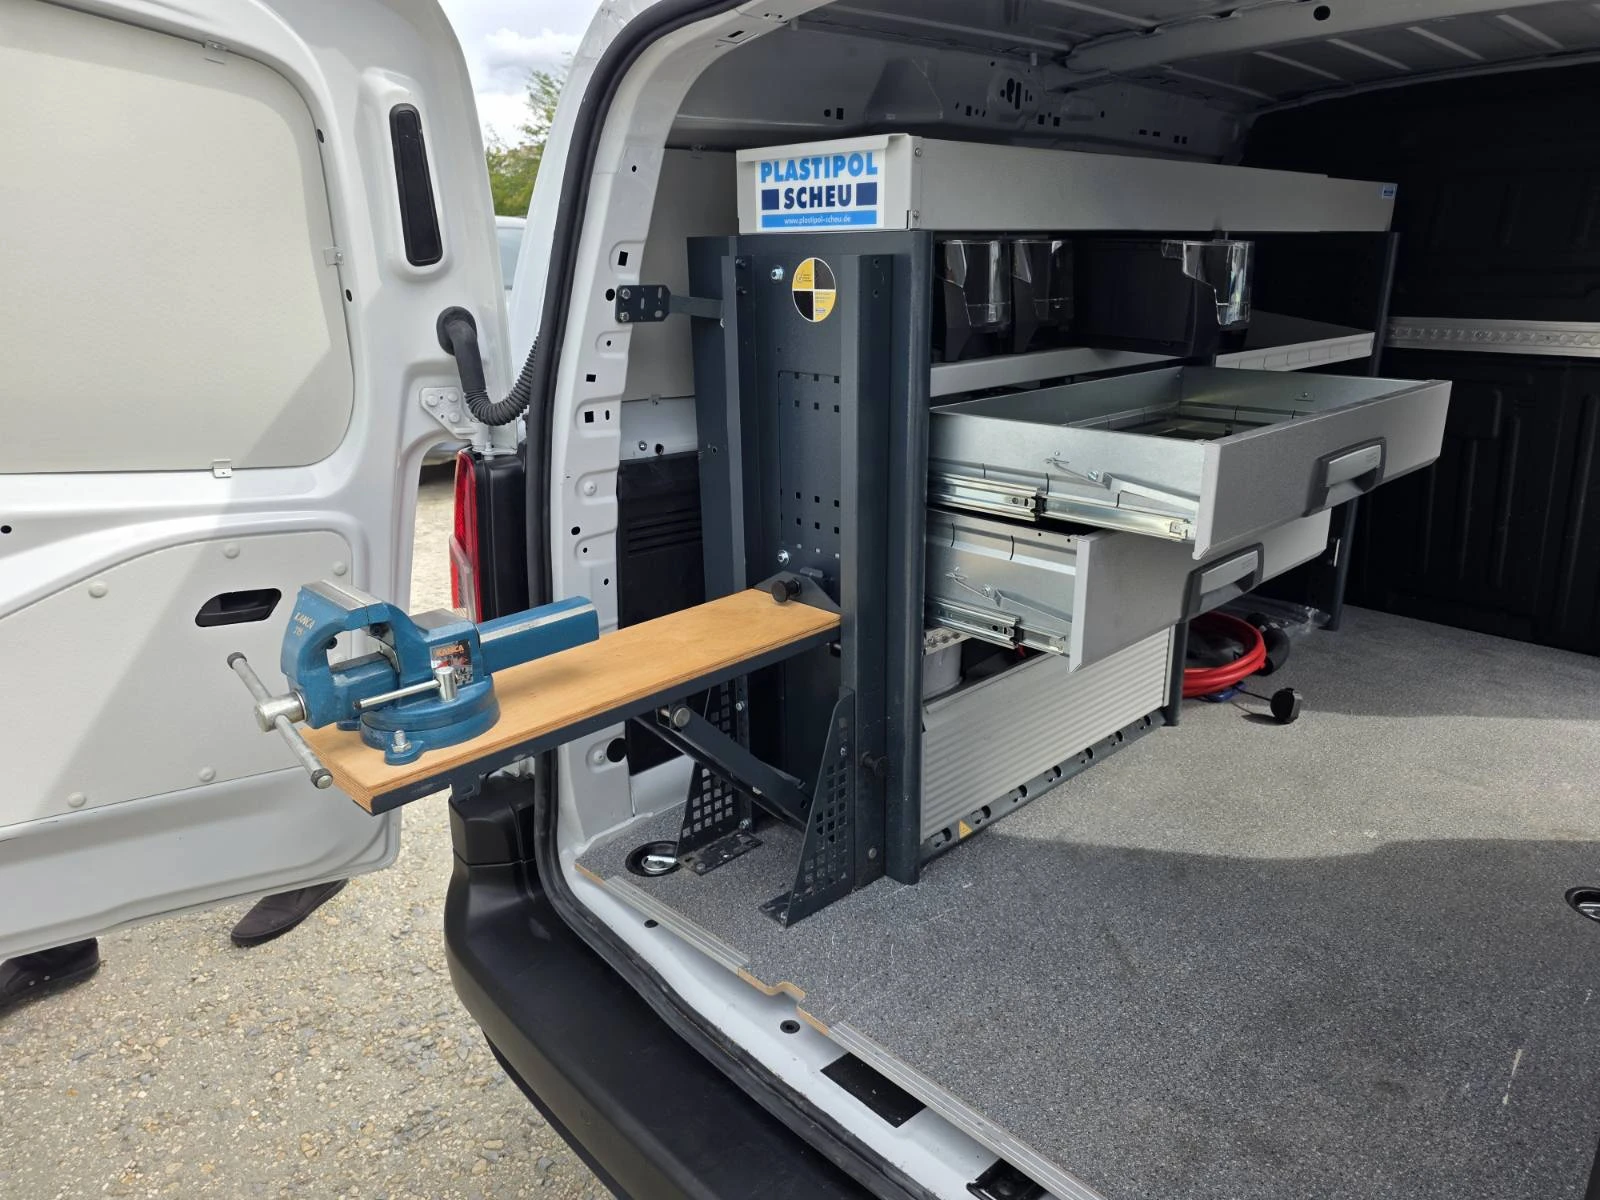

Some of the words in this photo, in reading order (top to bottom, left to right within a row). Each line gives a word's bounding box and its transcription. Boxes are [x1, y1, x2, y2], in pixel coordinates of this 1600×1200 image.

[760, 152, 878, 183] PLASTIPOL
[784, 183, 852, 210] SCHEU
[784, 215, 851, 226] www.plastipol-scheu.de
